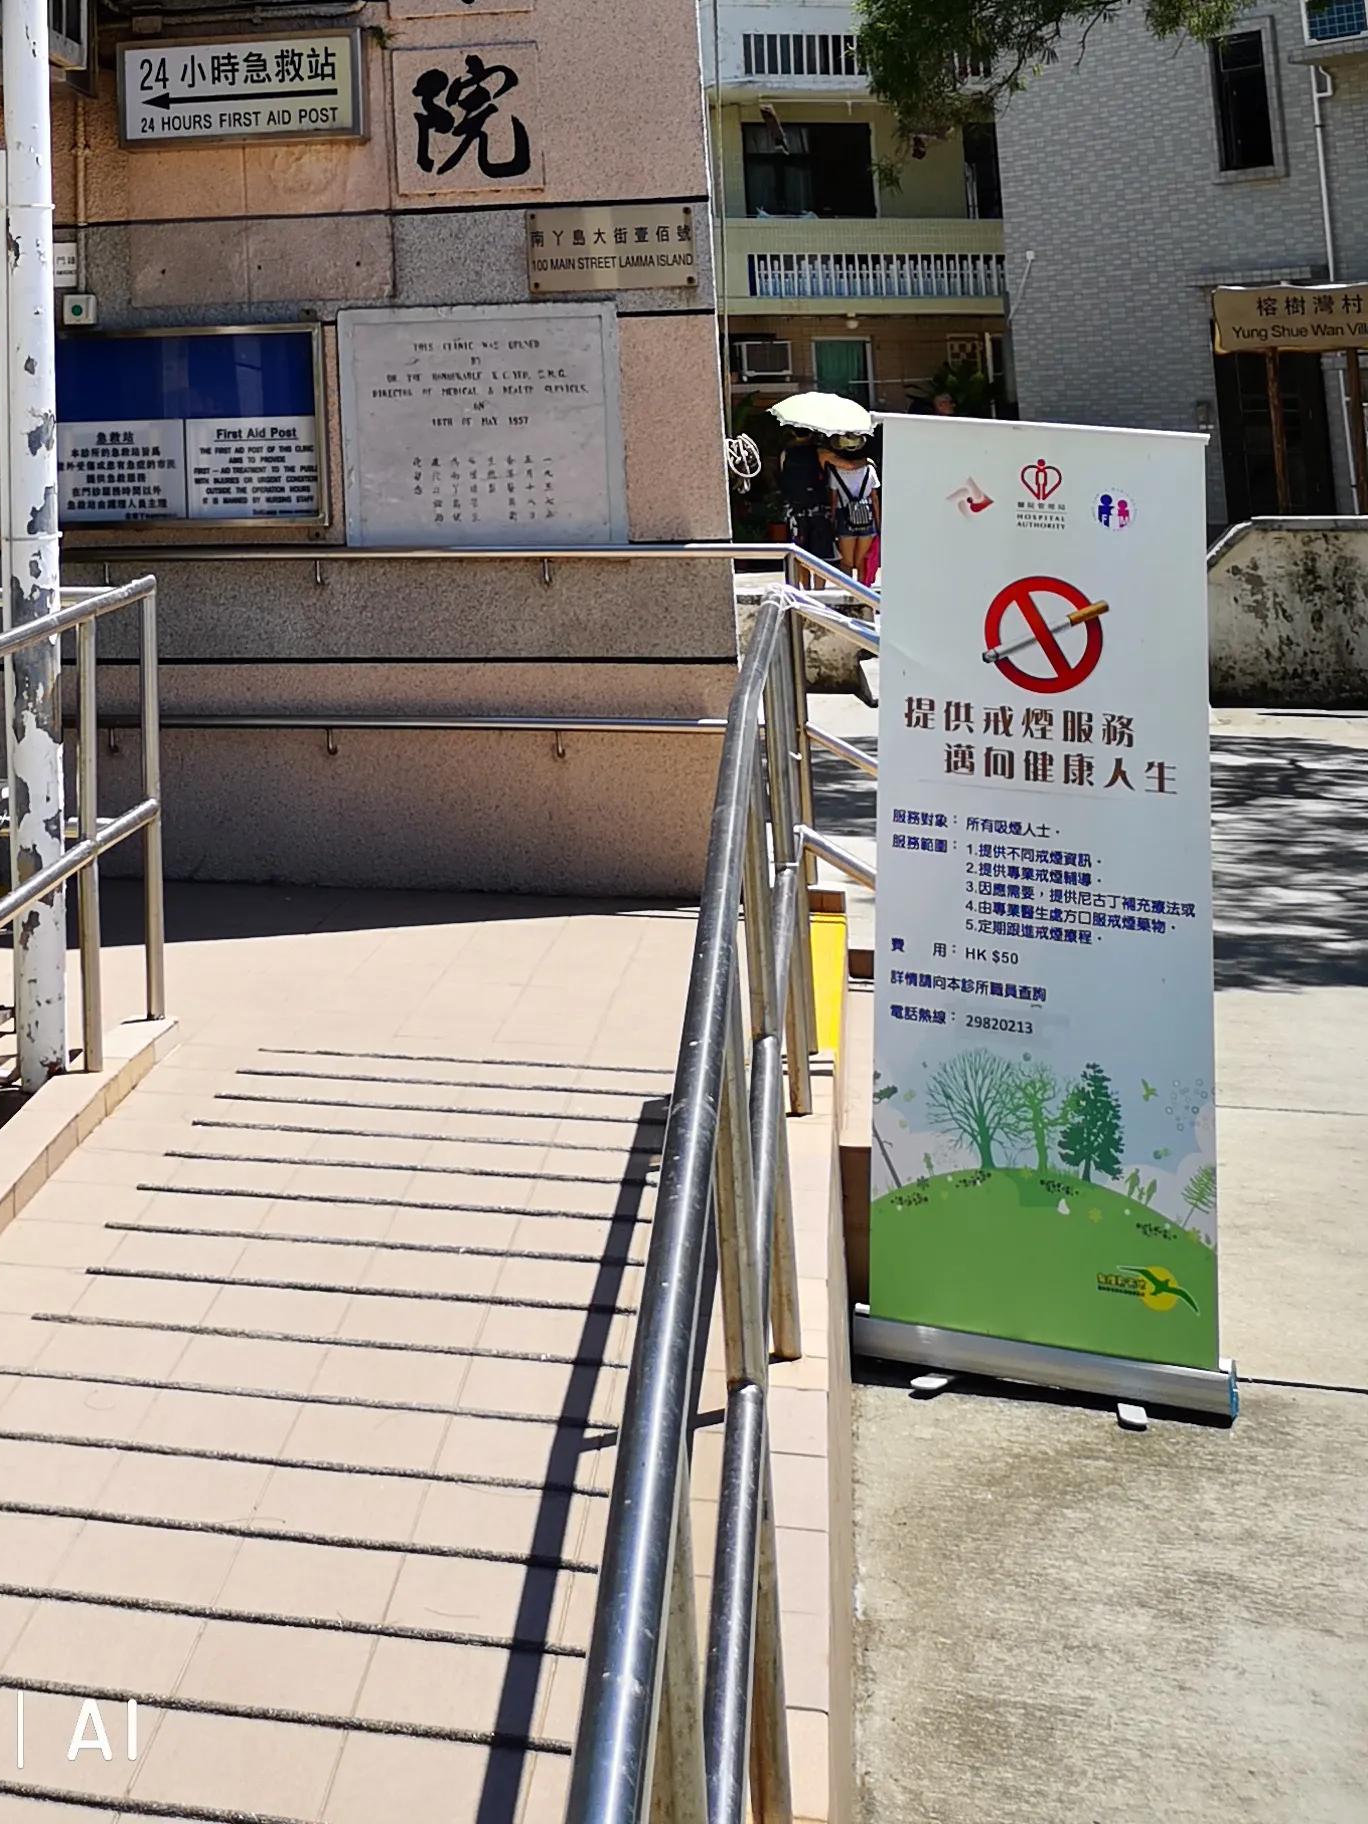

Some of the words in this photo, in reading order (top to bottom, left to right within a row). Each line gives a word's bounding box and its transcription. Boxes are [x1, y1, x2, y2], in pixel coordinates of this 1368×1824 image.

[140, 58, 169, 91] 24
[181, 46, 337, 89] 小時急救站
[141, 117, 155, 133] 24
[161, 114, 213, 132] HOURS
[219, 111, 261, 128] FIRST
[267, 110, 292, 126] AID
[299, 107, 339, 124] POST
[531, 224, 692, 249] 南丫島大街壹佰號
[533, 258, 548, 272] 100
[550, 257, 576, 271] MAIN
[578, 256, 616, 270] STREET
[619, 254, 655, 268] LAMMA
[657, 252, 694, 267] ISLAND
[1256, 293, 1364, 317] 榕樹灣村
[1232, 325, 1268, 342] Yung
[1271, 324, 1308, 338] Shue
[1311, 323, 1344, 337] Wan
[1347, 321, 1368, 336] Vill
[216, 428, 242, 439] First
[247, 428, 266, 438] Aid
[270, 427, 297, 438] Post
[1016, 513, 1065, 523] HOSPITAL
[1016, 521, 1066, 530] AUTHORITY
[904, 695, 1137, 749] 提供戒煙服務
[944, 742, 1179, 796] 邁向健康人生
[965, 947, 987, 962] HK
[992, 950, 1019, 965] $50
[965, 1014, 1034, 1035] 29820213
